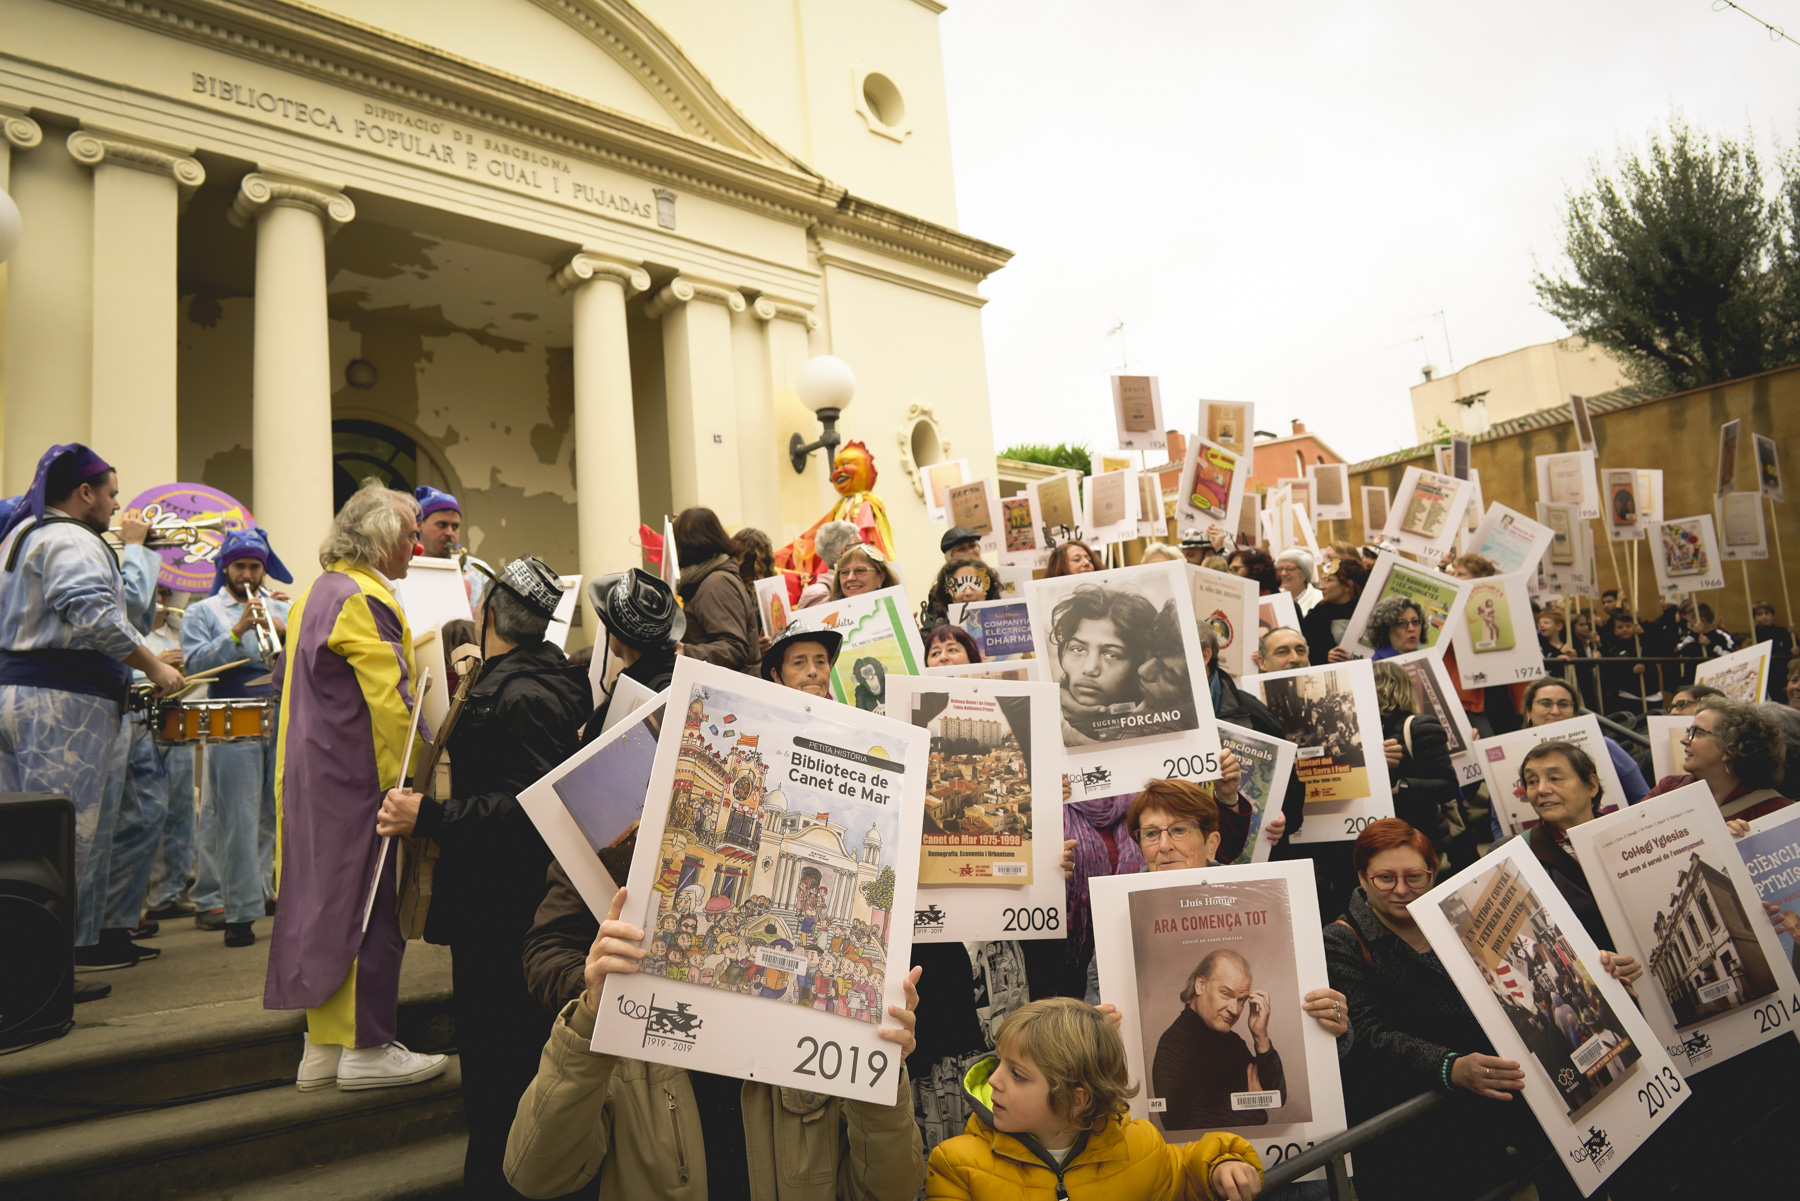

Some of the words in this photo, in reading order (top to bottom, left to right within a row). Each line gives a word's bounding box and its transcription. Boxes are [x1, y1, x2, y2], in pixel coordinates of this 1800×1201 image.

[191, 70, 343, 134] BIBLIOTECA
[354, 118, 456, 166] POPULAR
[466, 151, 478, 171] P.
[486, 159, 543, 190] GUAL
[552, 176, 560, 194] I
[572, 180, 652, 219] PUJADAS
[453, 129, 474, 145] DE
[484, 138, 572, 175] BARCELONA
[1205, 585, 1215, 595] AÑO
[1223, 590, 1242, 601] DILUVIO
[1390, 585, 1413, 599] MALVES
[1395, 573, 1406, 582] ELS
[1406, 576, 1439, 594] BARRUFETS
[1396, 581, 1407, 590] LES
[1407, 584, 1439, 601] MONGETES
[1699, 579, 1722, 589] 1966
[1514, 666, 1542, 679] 1974
[1092, 718, 1120, 728] EUGENI
[1120, 709, 1182, 728] FORCANO
[1549, 733, 1567, 743] meu
[1567, 729, 1587, 738] pare
[808, 741, 833, 754] PETITA
[833, 748, 868, 763] HISTÒRIA
[1223, 739, 1273, 761] nacionals
[790, 751, 867, 784] Biblioteca
[870, 773, 889, 789] de
[1163, 752, 1219, 780] 2005
[1313, 765, 1332, 775] Serra
[788, 767, 834, 792] Canet
[838, 781, 856, 797] de
[860, 785, 890, 805] Mar
[1344, 815, 1387, 835] 200
[922, 834, 948, 846] Canet
[948, 834, 960, 845] de
[960, 835, 978, 846] Mar
[978, 834, 1021, 847] 1975-1998
[1651, 827, 1690, 849] Yglesias
[959, 849, 984, 858] Economia
[987, 849, 1016, 858] Urbanisme
[1617, 869, 1630, 879] Cent
[1629, 864, 1642, 874] anys
[1641, 860, 1647, 868] al
[1647, 855, 1663, 867] servei
[1662, 853, 1670, 861] de
[1179, 898, 1203, 909] Lluís
[1205, 896, 1238, 906] Homar
[1465, 927, 1477, 943] UN
[1472, 897, 1495, 932] ANTÍDOT
[1490, 871, 1511, 901] CONTRA
[1002, 906, 1060, 932] 2008
[1153, 918, 1178, 934] ARA
[1181, 912, 1243, 931] COMENÇA
[1244, 909, 1268, 926] TOT
[1476, 906, 1505, 949] L'EXTREMA
[1499, 884, 1517, 911] DRETA
[930, 927, 943, 935] 2019
[1490, 934, 1505, 955] TONI
[1753, 992, 1800, 1034] 2014
[647, 1036, 667, 1048] 1919
[672, 1041, 693, 1053] 2019
[792, 1035, 889, 1088] 2019
[1637, 1065, 1682, 1119] 2013
[1150, 1100, 1163, 1108] ara
